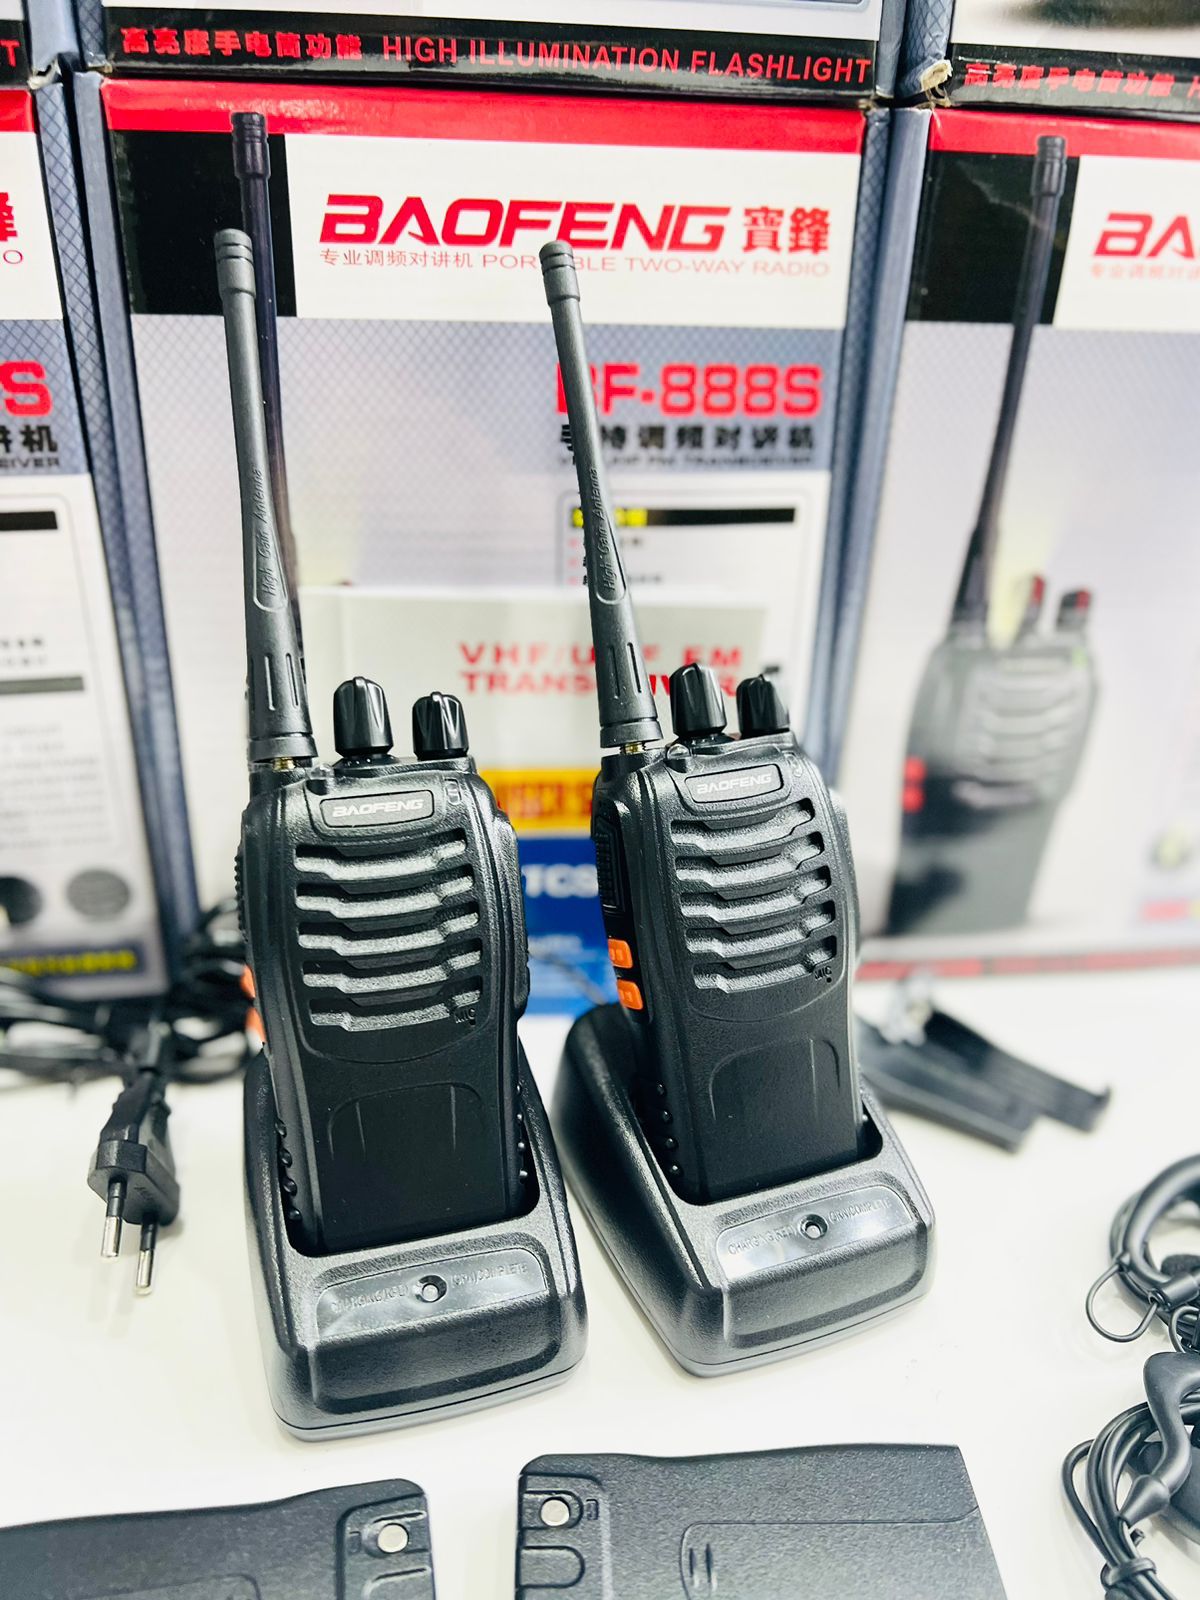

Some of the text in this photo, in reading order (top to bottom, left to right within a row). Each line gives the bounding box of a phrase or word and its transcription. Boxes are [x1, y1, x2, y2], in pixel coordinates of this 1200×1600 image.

[121, 28, 363, 61] 高亮度手电筒功能
[382, 35, 872, 84] HIGH ILLUMINATION FLASHLIGHT
[319, 193, 732, 253] BAOFENG
[742, 206, 831, 254] 寶鋒
[1094, 212, 1195, 259] BA
[319, 249, 474, 269] 专业调频对讲机
[482, 253, 832, 278] PORBLE TWO-WAY RADIO
[252, 469, 268, 523] Antenna
[589, 468, 617, 591] High Gain Antenna
[258, 567, 278, 596] High
[696, 772, 773, 795] BAOFENG
[332, 798, 425, 818] BAOFENG
